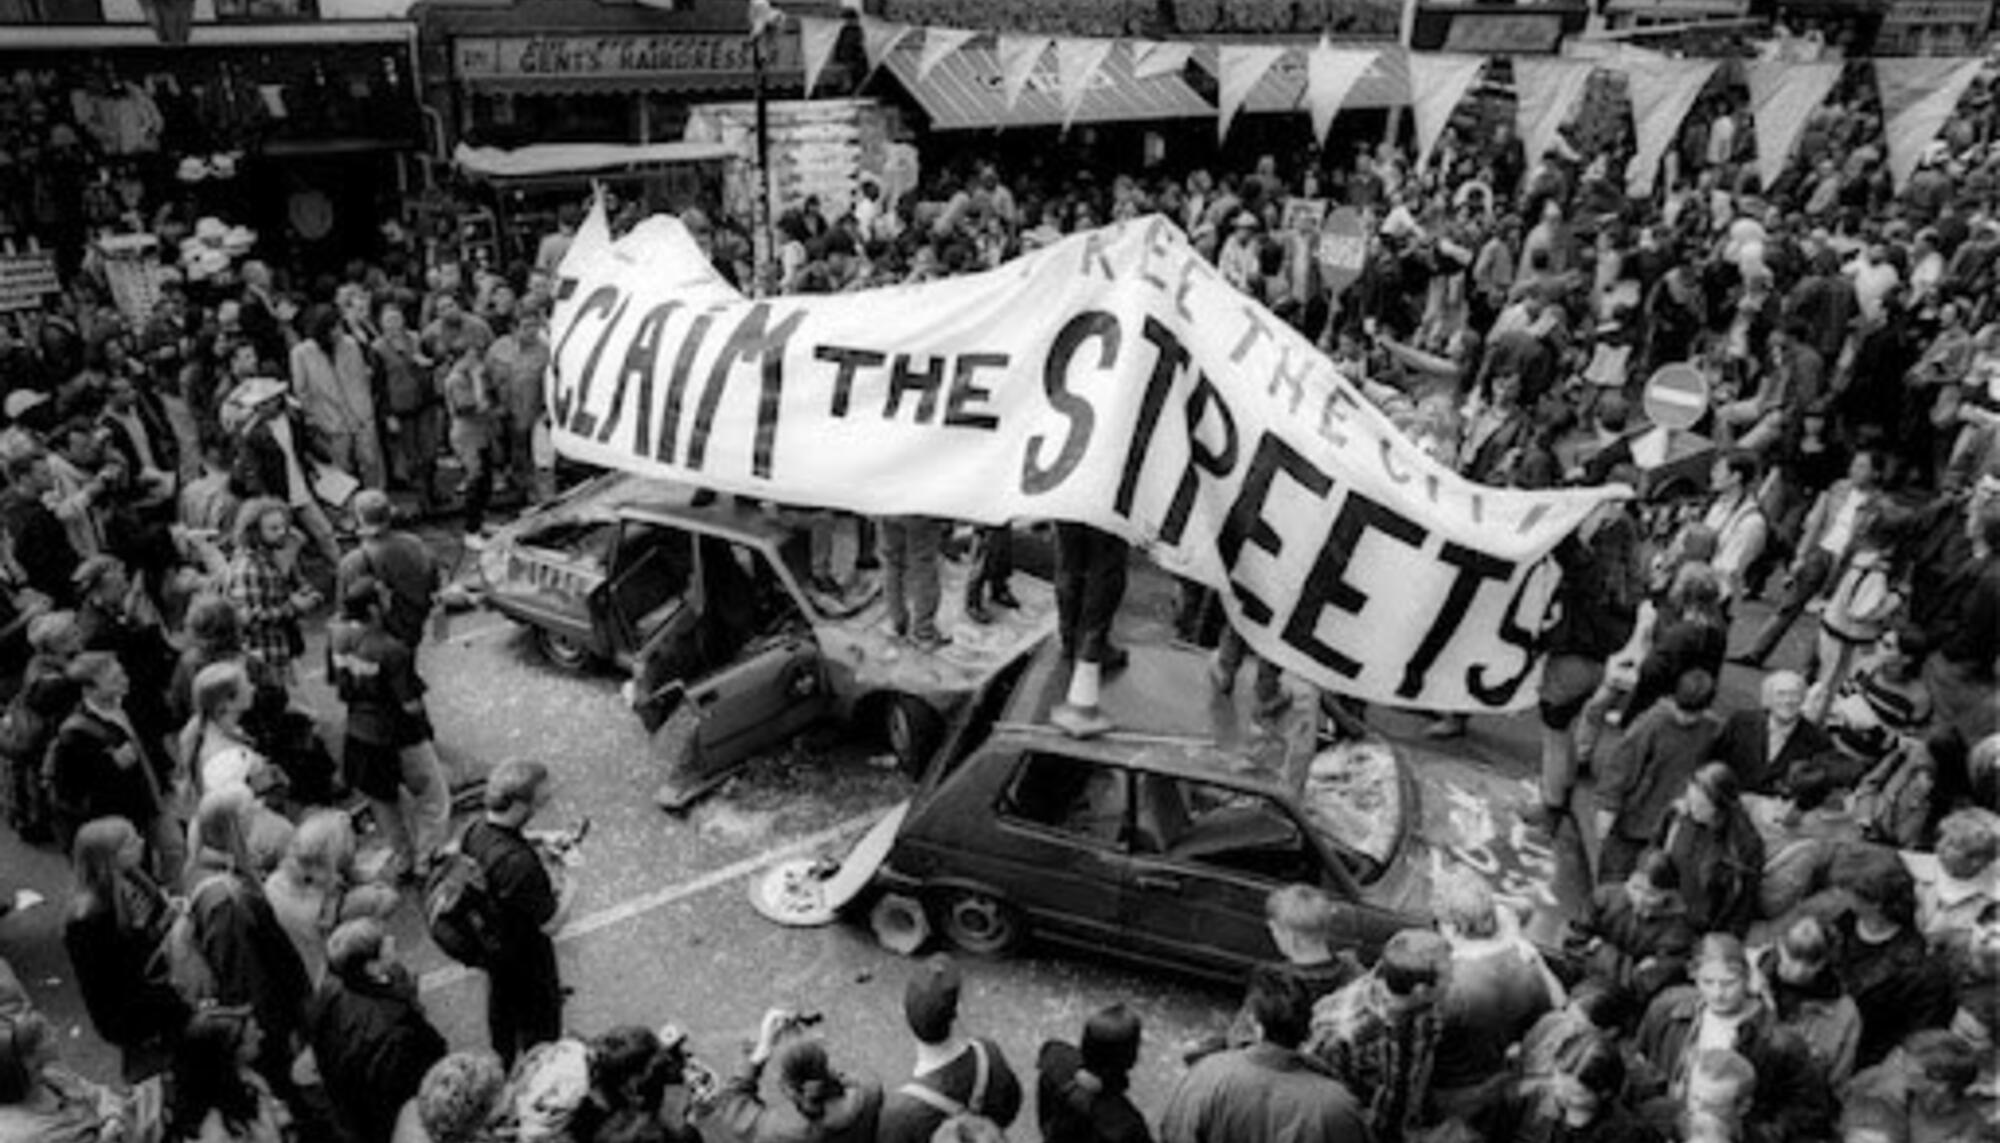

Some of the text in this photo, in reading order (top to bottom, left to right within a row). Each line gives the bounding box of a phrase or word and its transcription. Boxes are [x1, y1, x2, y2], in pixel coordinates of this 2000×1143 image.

[619, 49, 779, 70] HAIRDRESS
[1019, 213, 1215, 324] REE
[1230, 304, 1361, 447] THE
[549, 278, 1553, 707] CLAIM THE STREETS
